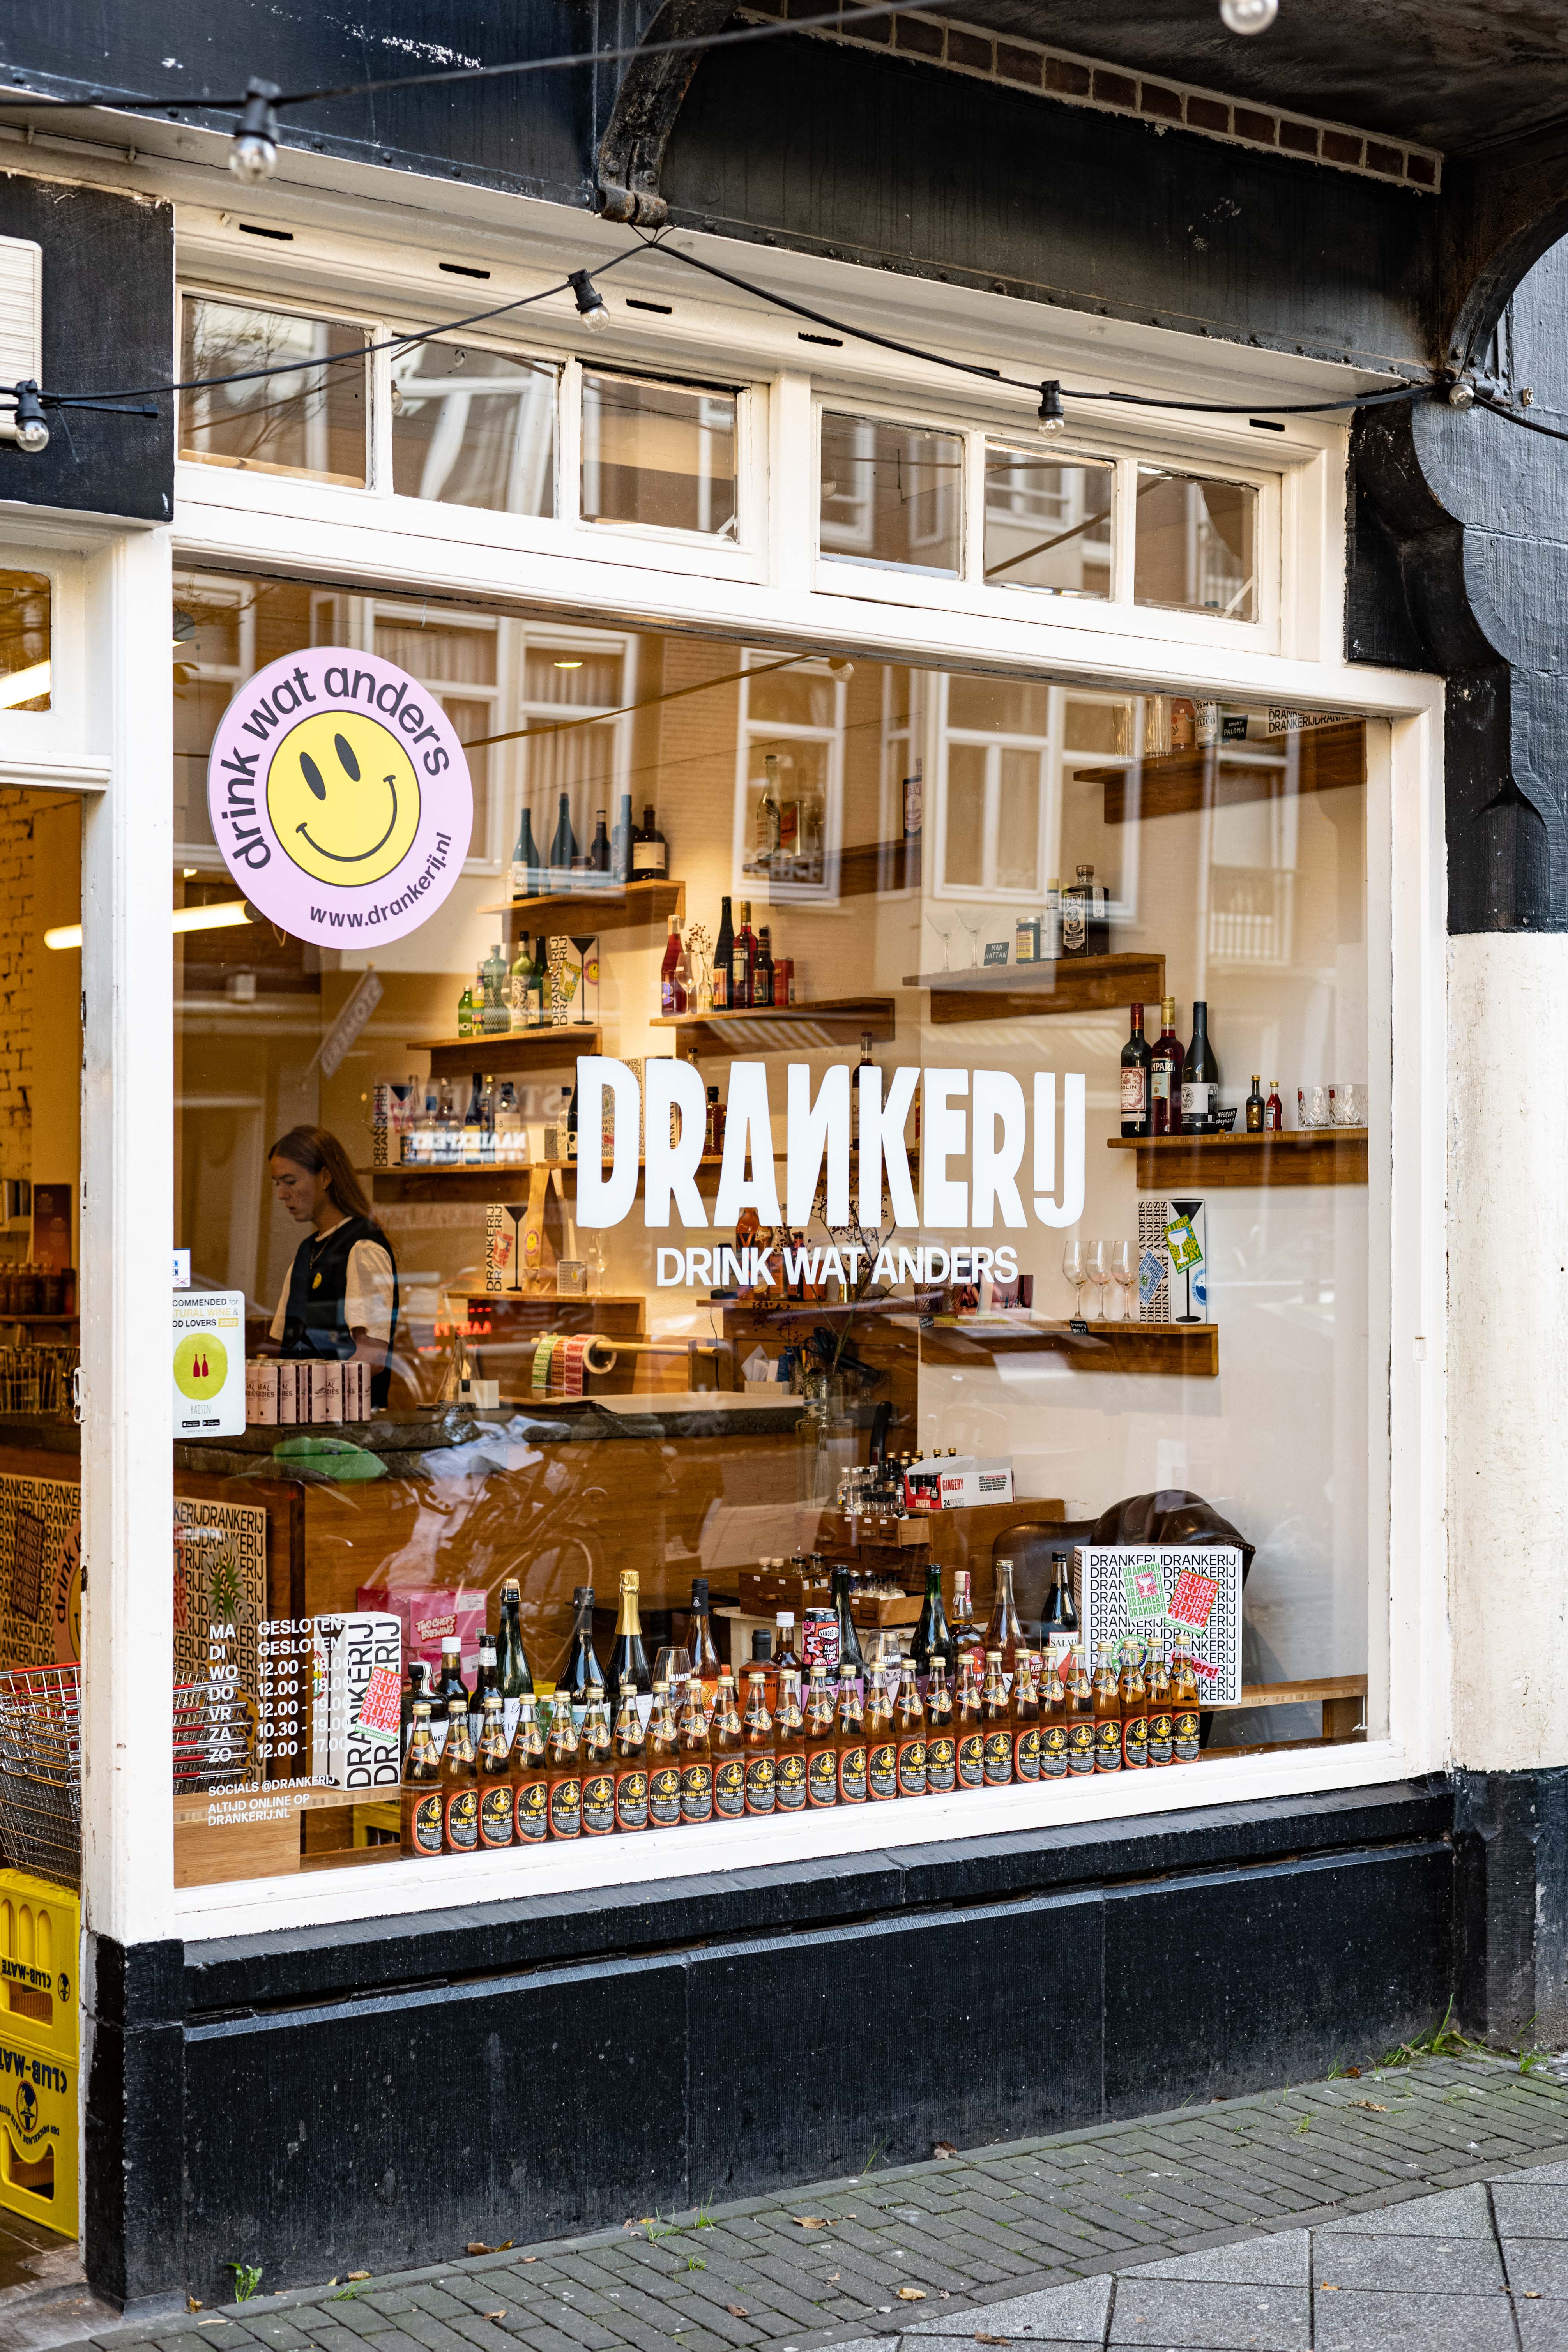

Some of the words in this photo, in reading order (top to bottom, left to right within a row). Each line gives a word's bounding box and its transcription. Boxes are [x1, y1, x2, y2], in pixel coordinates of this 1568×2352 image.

[242, 667, 316, 741] wat
[324, 667, 449, 776] anders
[1224, 727, 1244, 736] PALOMA
[220, 746, 271, 869] drink
[311, 832, 452, 928] www.drankerij.nl
[656, 1246, 776, 1286] DRINK
[785, 1247, 866, 1285] WAT
[871, 1246, 1018, 1284] ANDERS
[207, 1308, 231, 1316] WINE
[191, 1405, 211, 1414] RAISIN
[942, 1478, 964, 1491] GINGERY
[1177, 1582, 1214, 1601] SLURP
[1180, 1572, 1218, 1591] SLURP
[1170, 1601, 1208, 1619] SLURP
[1174, 1591, 1212, 1610] SLURP
[210, 1624, 236, 1640] MA
[258, 1617, 341, 1636] GESLOTEN
[415, 1620, 431, 1632] TWO
[432, 1614, 456, 1627] CHEFS
[1170, 1610, 1205, 1627] AWAY
[421, 1624, 455, 1640] BREWING
[209, 1645, 226, 1660] DI
[258, 1637, 341, 1656] GESLOTEN
[209, 1665, 238, 1681] WO
[258, 1660, 298, 1677] 12.00
[311, 1656, 352, 1672] 18.00
[209, 1686, 233, 1701] DO
[257, 1680, 298, 1697] 12.00
[311, 1676, 352, 1692] 18.00
[209, 1707, 232, 1722] VR
[257, 1700, 298, 1718] 12.00
[311, 1696, 351, 1713] 19.00
[347, 1624, 373, 1789] DRANKERIJ
[362, 1703, 401, 1724] SLURP
[209, 1727, 232, 1742] ZA
[257, 1721, 298, 1738] 10.30
[311, 1717, 351, 1733] 19.00
[355, 1726, 395, 1743] WWW.DRANKERIJ.NL
[208, 1747, 232, 1763] ZO
[257, 1741, 298, 1758] 12.00
[311, 1736, 350, 1753] 17.00
[208, 1782, 259, 1797] SOCIALS
[262, 1774, 335, 1793] @DRANKERIJ
[208, 1799, 246, 1814] ALTIJD
[249, 1795, 291, 1810] ONLINE
[294, 1794, 310, 1804] OP
[208, 1808, 290, 1827] DRANKERIJ.NL
[1, 1959, 51, 1989] CLUB-MATE
[50, 2125, 60, 2136] DER
